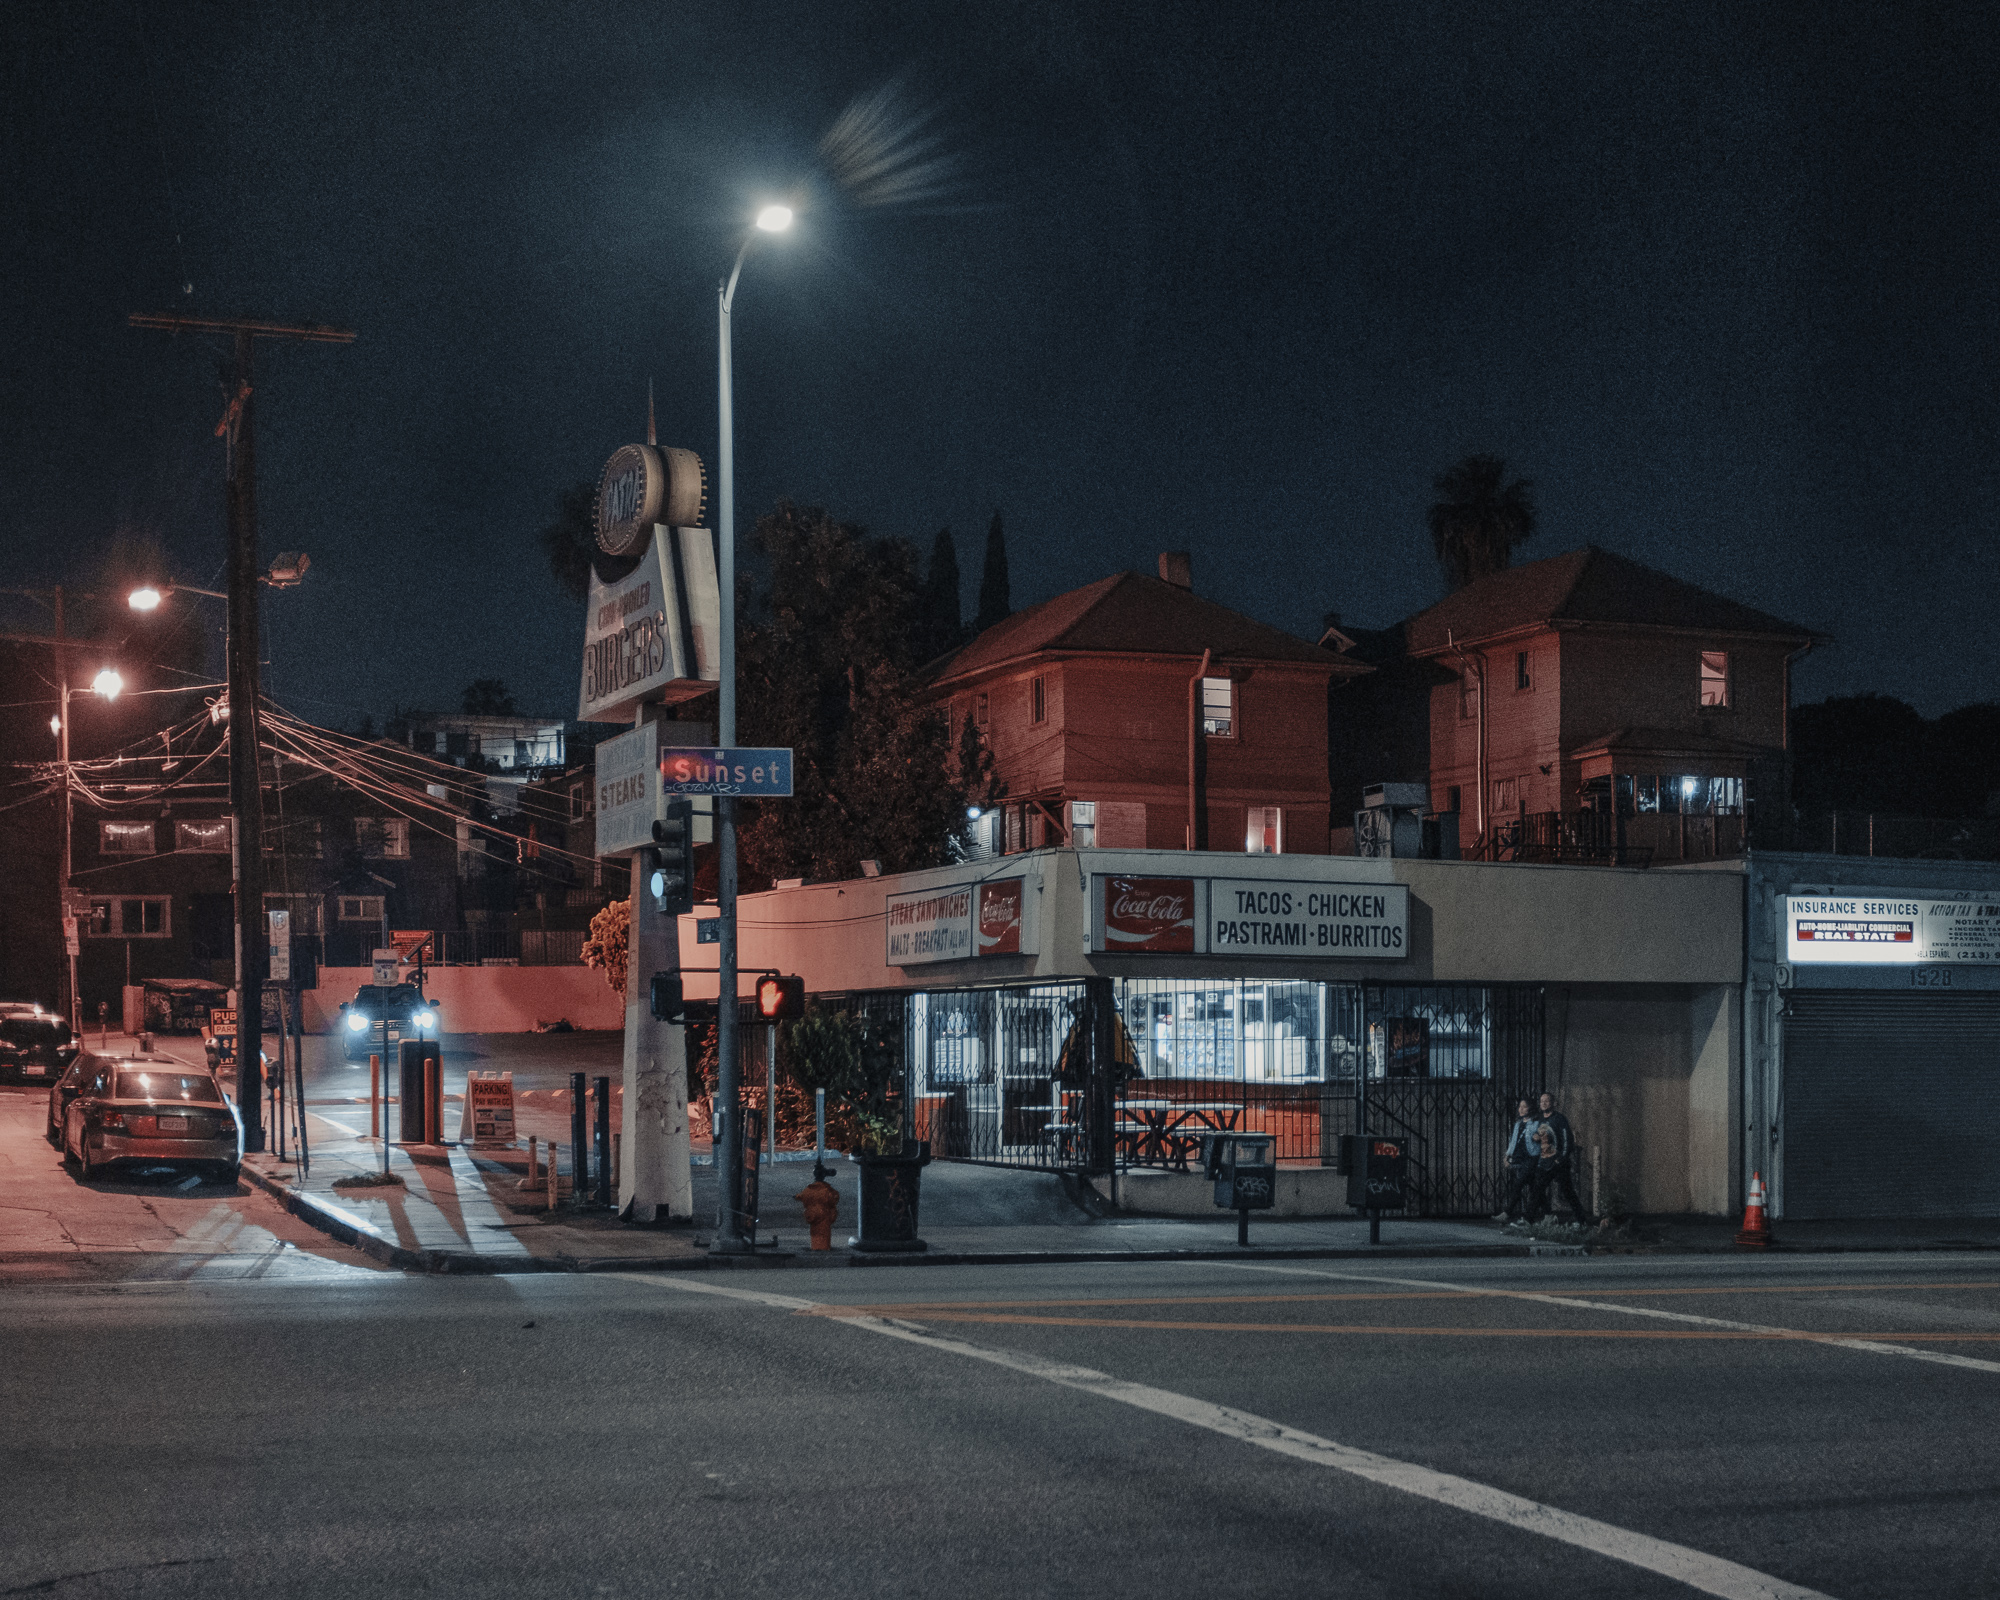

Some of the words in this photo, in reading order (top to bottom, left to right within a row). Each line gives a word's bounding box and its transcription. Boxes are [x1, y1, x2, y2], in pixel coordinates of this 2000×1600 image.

[585, 610, 664, 703] BURGERS
[674, 758, 780, 784] Sunset
[600, 772, 645, 811] STEAKS
[890, 901, 914, 926] STEAK
[916, 893, 969, 923] SANDWICHES
[1235, 890, 1292, 915] TACOS
[1308, 894, 1385, 918] CHICKEN
[1792, 901, 1857, 914] INSURANCE
[1863, 902, 1919, 916] SERVICES
[1928, 904, 1956, 916] ACTION
[1956, 904, 1972, 916] TAX
[1217, 920, 1307, 946] PASTRAMI
[1317, 924, 1403, 948] BURRITOS
[1813, 932, 1851, 940] REAL
[1868, 923, 1911, 932] COMMERCIAL
[1957, 951, 1990, 959] (213)
[1910, 969, 1952, 986] 1528
